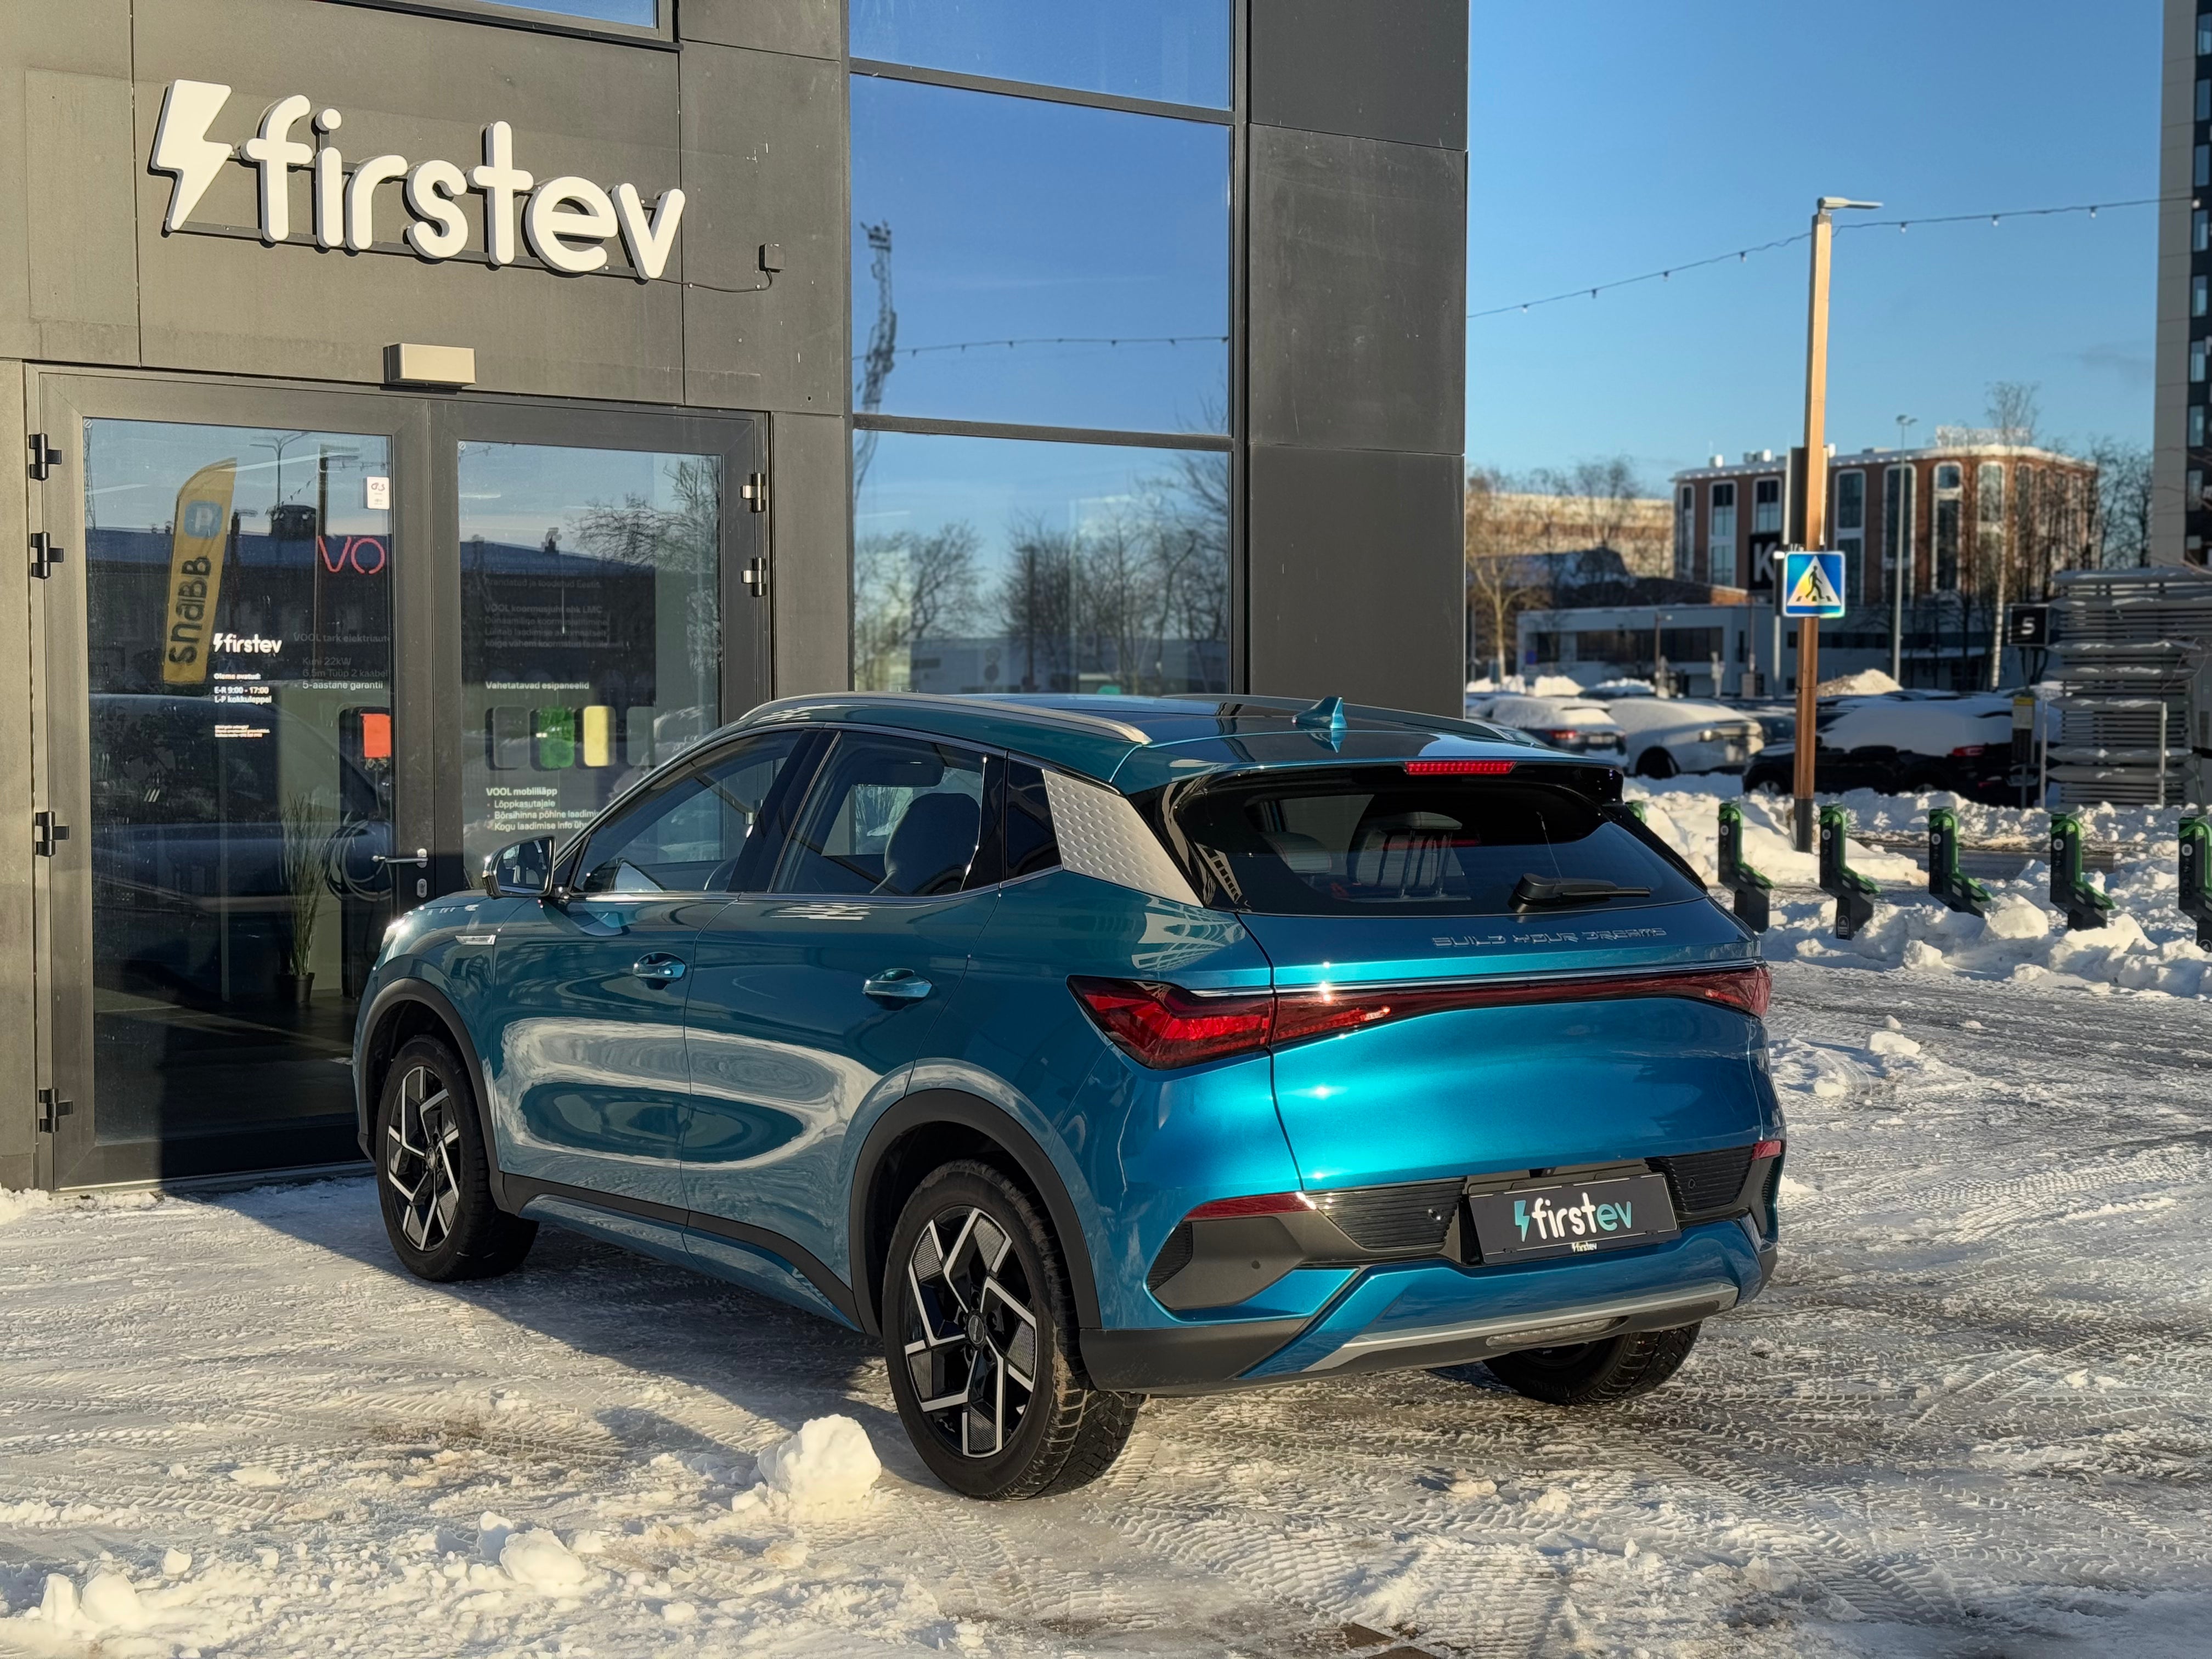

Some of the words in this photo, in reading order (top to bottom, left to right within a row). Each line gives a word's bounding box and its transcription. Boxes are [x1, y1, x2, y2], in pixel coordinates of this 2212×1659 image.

[239, 93, 686, 279] firstev
[224, 633, 282, 653] firstev
[486, 788, 512, 797] VOOL
[1431, 935, 1506, 948] BUILD
[1512, 931, 1579, 944] YOUR
[1531, 1192, 1633, 1240] firstev
